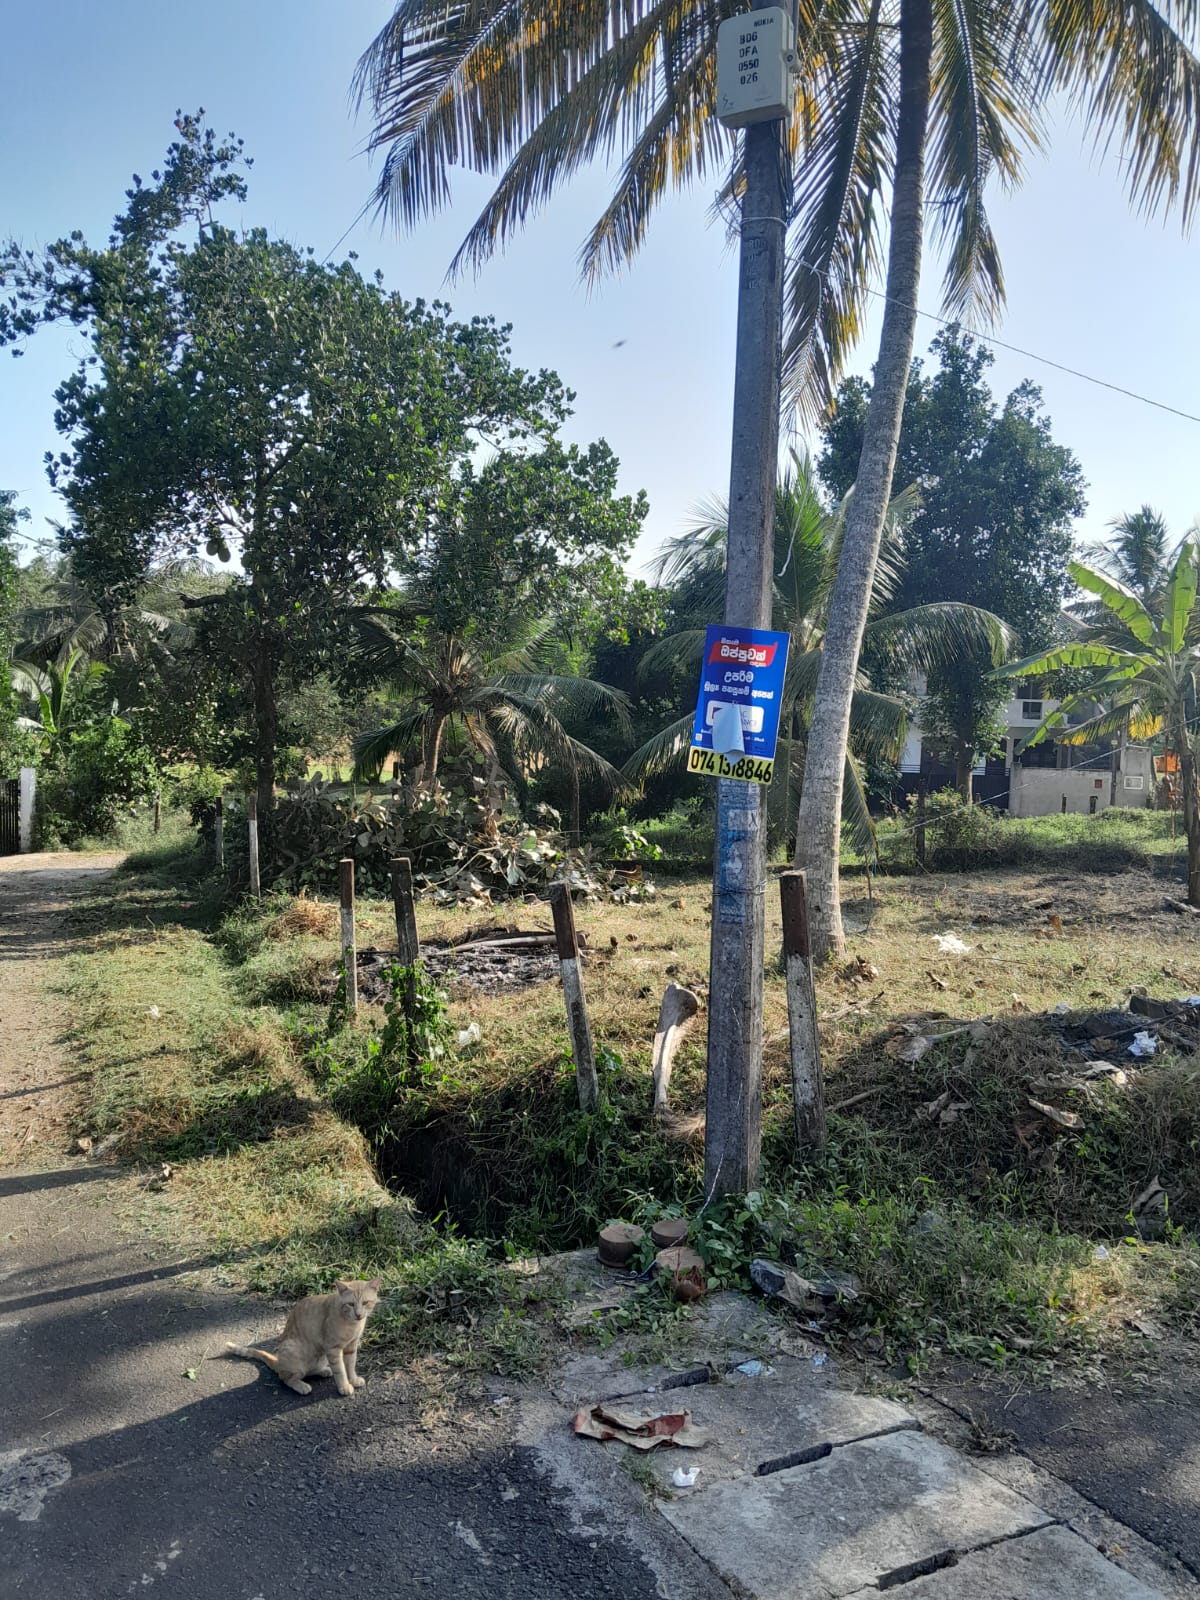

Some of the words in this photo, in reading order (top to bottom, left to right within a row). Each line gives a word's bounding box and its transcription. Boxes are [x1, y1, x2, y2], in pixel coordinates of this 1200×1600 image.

[739, 31, 758, 44] BDG
[724, 670, 754, 683] උපරිම
[691, 749, 715, 773] 074
